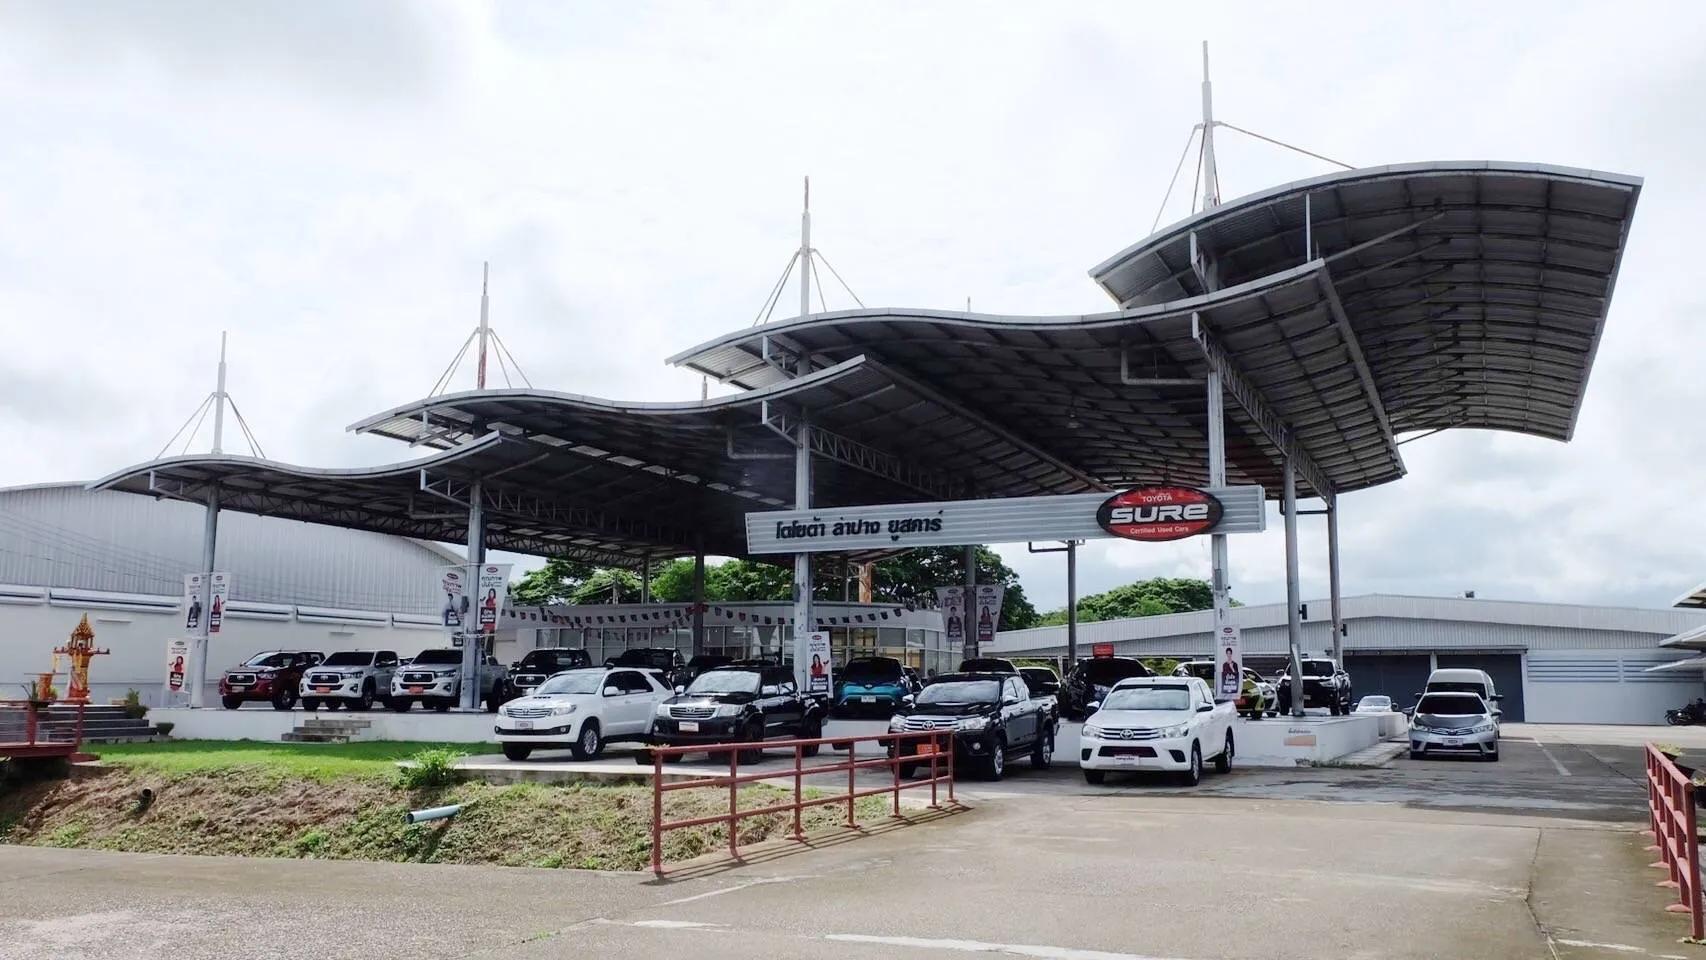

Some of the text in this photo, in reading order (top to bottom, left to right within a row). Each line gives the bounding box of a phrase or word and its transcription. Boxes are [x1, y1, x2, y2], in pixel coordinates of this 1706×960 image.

[1143, 495, 1172, 503] TOYOTA
[776, 516, 826, 539] โตโยต้า
[832, 516, 881, 536] ลำปาง
[1130, 525, 1189, 535] Certified Used Cars
